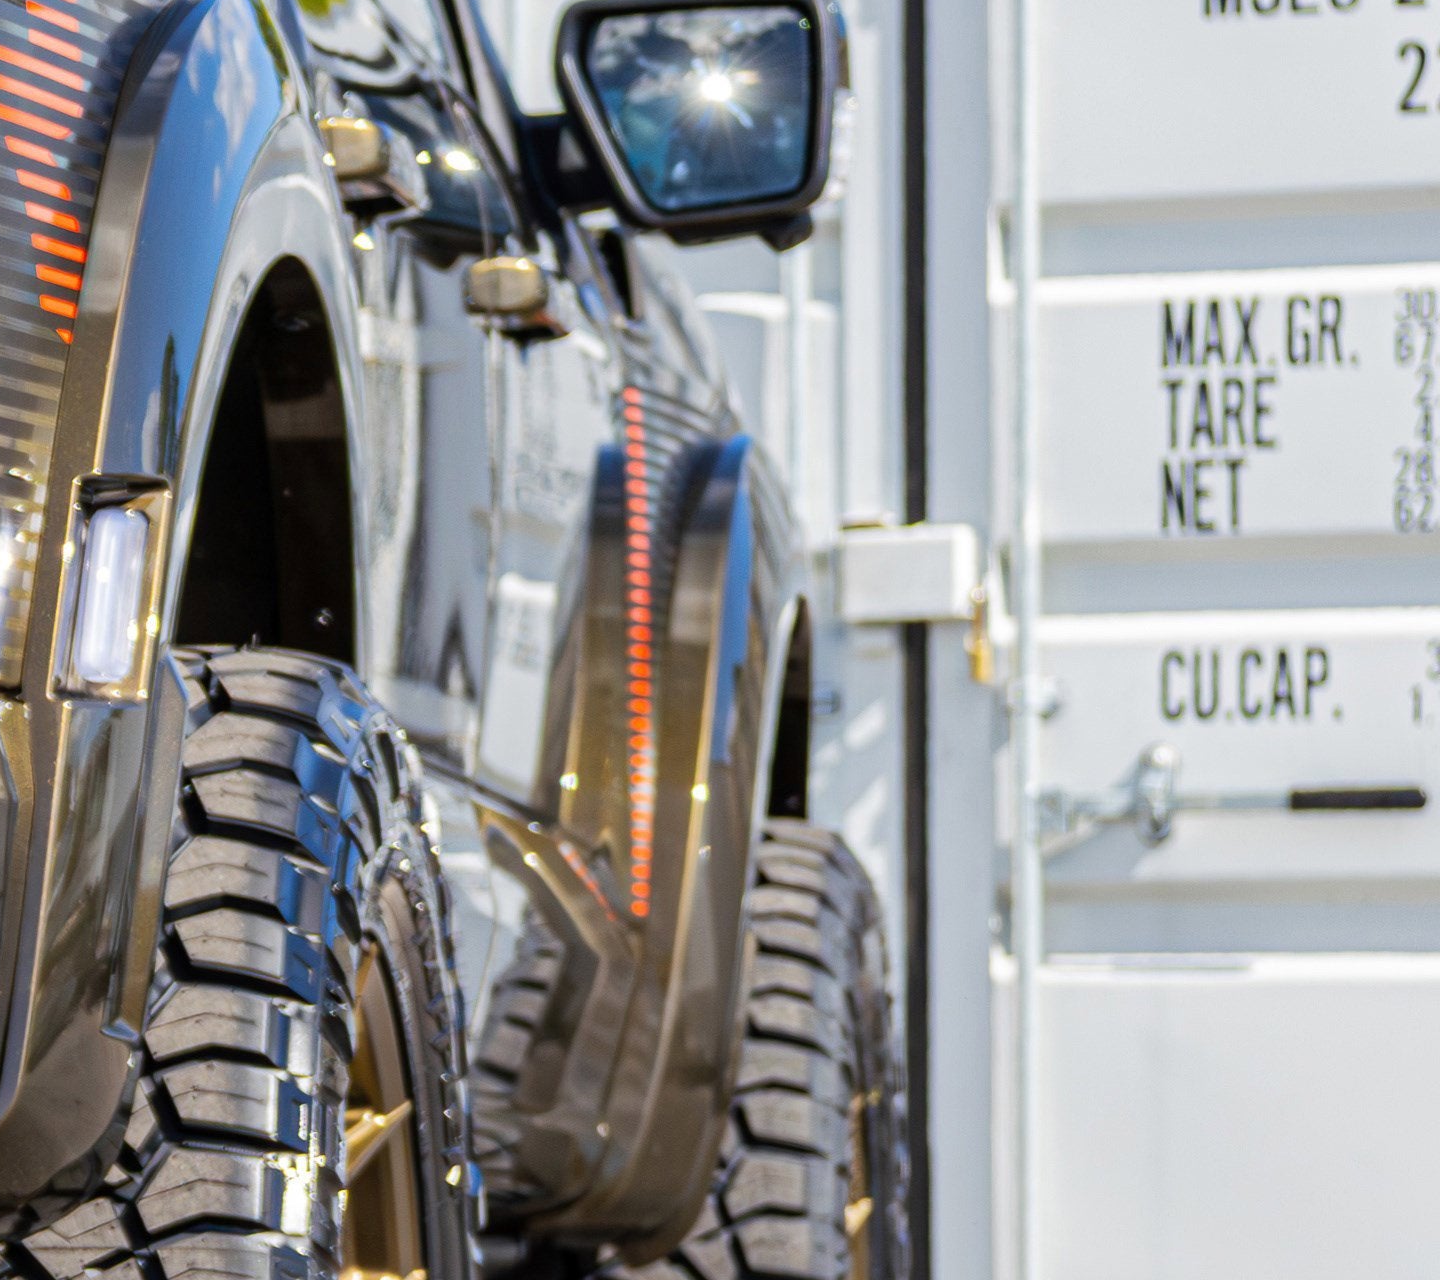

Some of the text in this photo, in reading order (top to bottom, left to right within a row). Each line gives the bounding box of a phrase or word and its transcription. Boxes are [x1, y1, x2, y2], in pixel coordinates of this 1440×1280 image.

[1162, 375, 1277, 451] TARE
[1162, 457, 1248, 532] NET
[1393, 447, 1436, 485] 28
